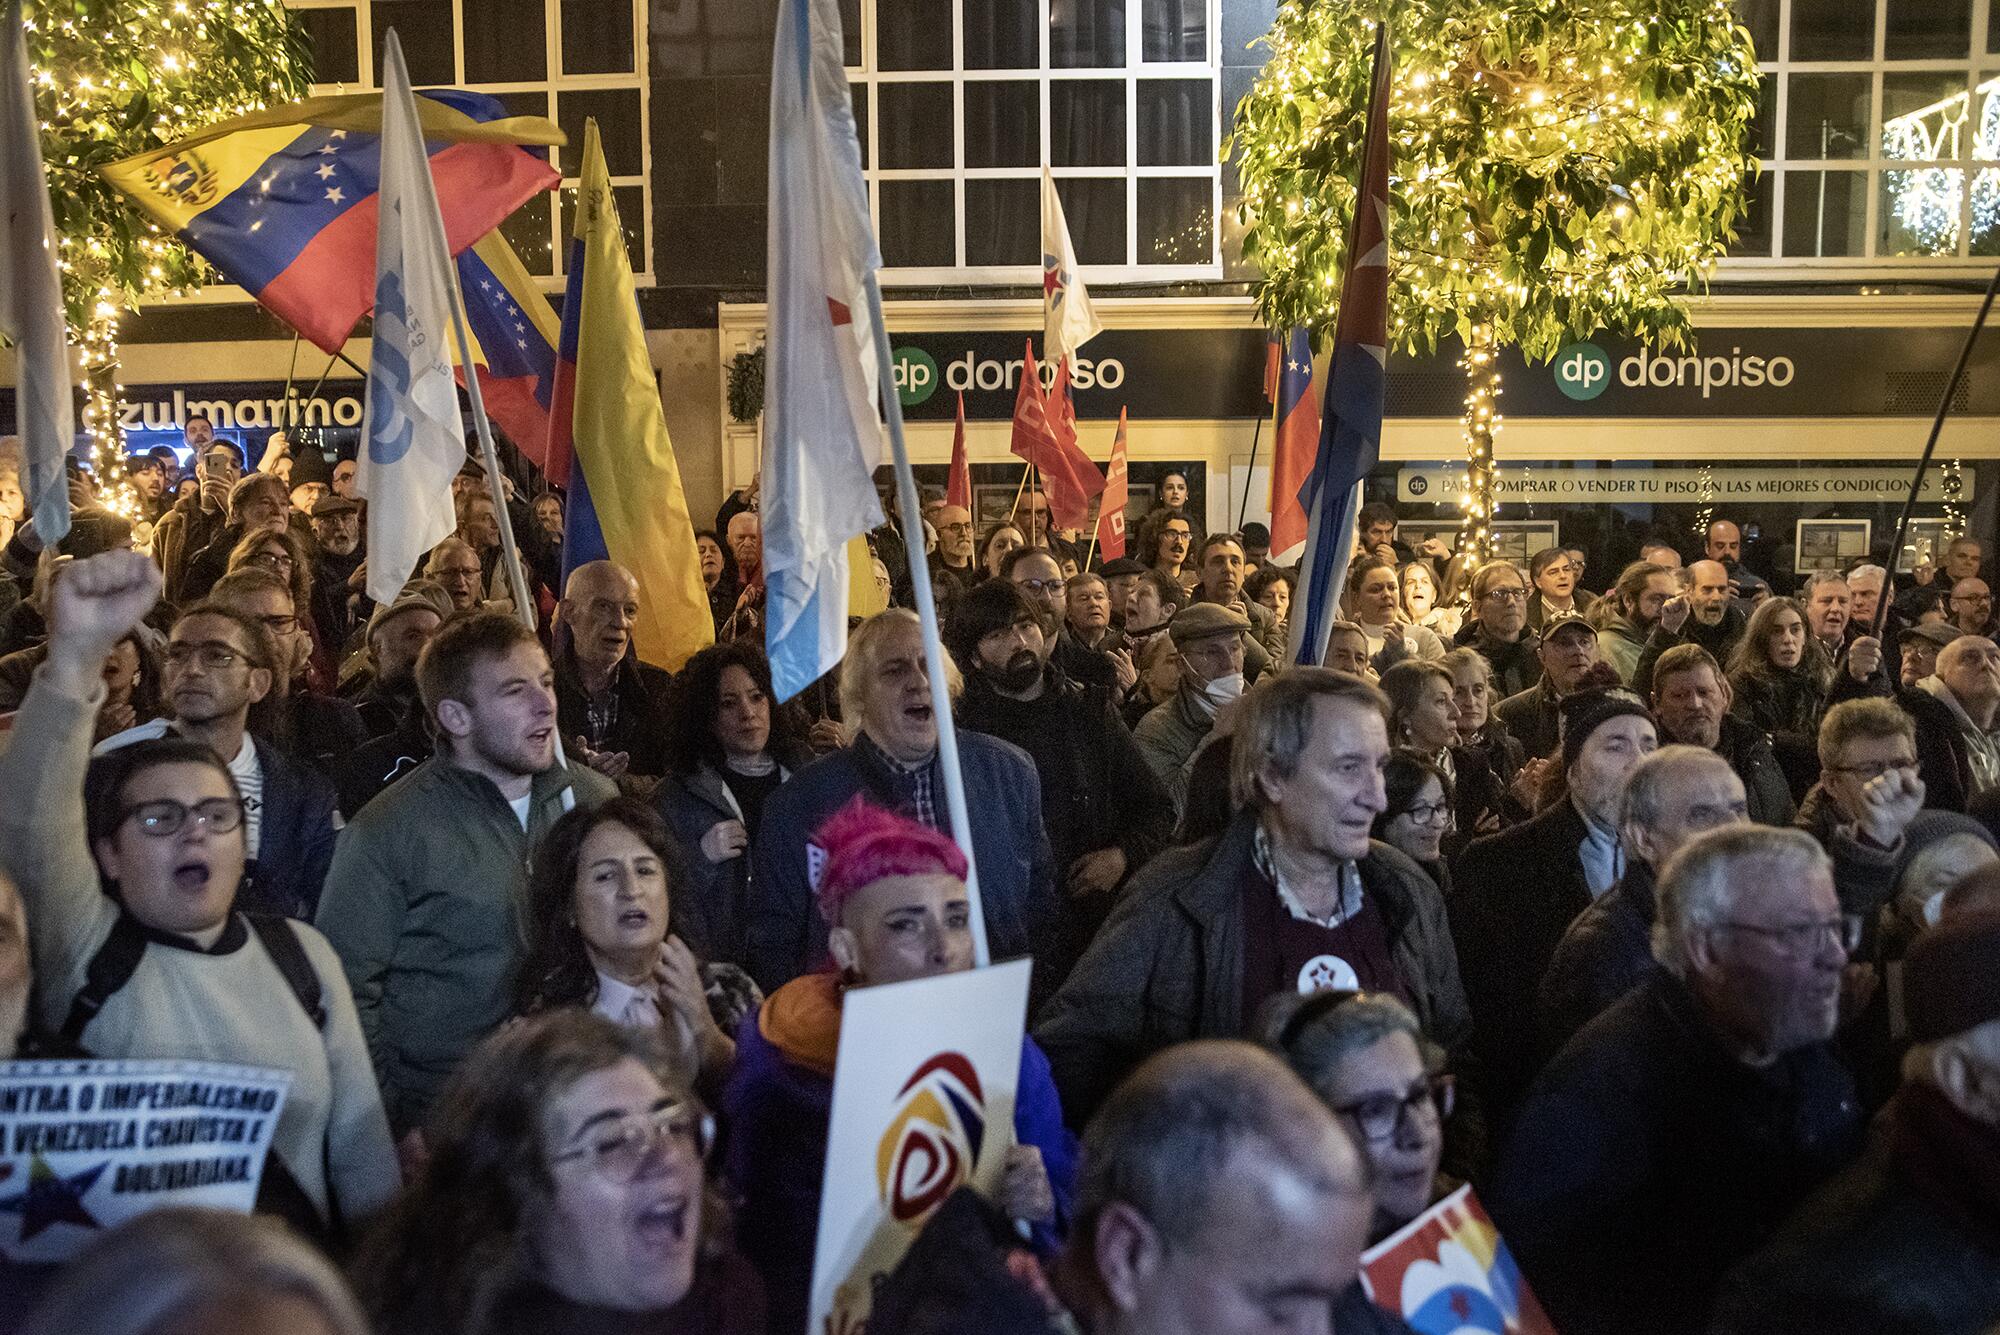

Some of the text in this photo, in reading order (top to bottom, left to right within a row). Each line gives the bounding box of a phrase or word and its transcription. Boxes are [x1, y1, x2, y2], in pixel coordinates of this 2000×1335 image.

[892, 351, 1125, 392] dp donpso
[1562, 347, 1795, 398] dp donpiso
[1410, 477, 1426, 492] dp
[1442, 480, 1476, 492] PAR
[1489, 480, 1558, 492] OMPRAR
[1561, 480, 1574, 493] O
[1578, 480, 1636, 492] VENDER
[1639, 479, 1659, 492] TU
[1665, 481, 1698, 493] PISO
[1703, 481, 1722, 492] EN
[1727, 481, 1752, 493] LAS
[1756, 480, 1819, 494] MEJORES
[1820, 479, 1930, 493] CONDICIONS
[0, 1082, 279, 1113] NTRA O IMPERIALISMO
[15, 1120, 136, 1153] VENEZUELA
[145, 1117, 246, 1148] CHAVISTA
